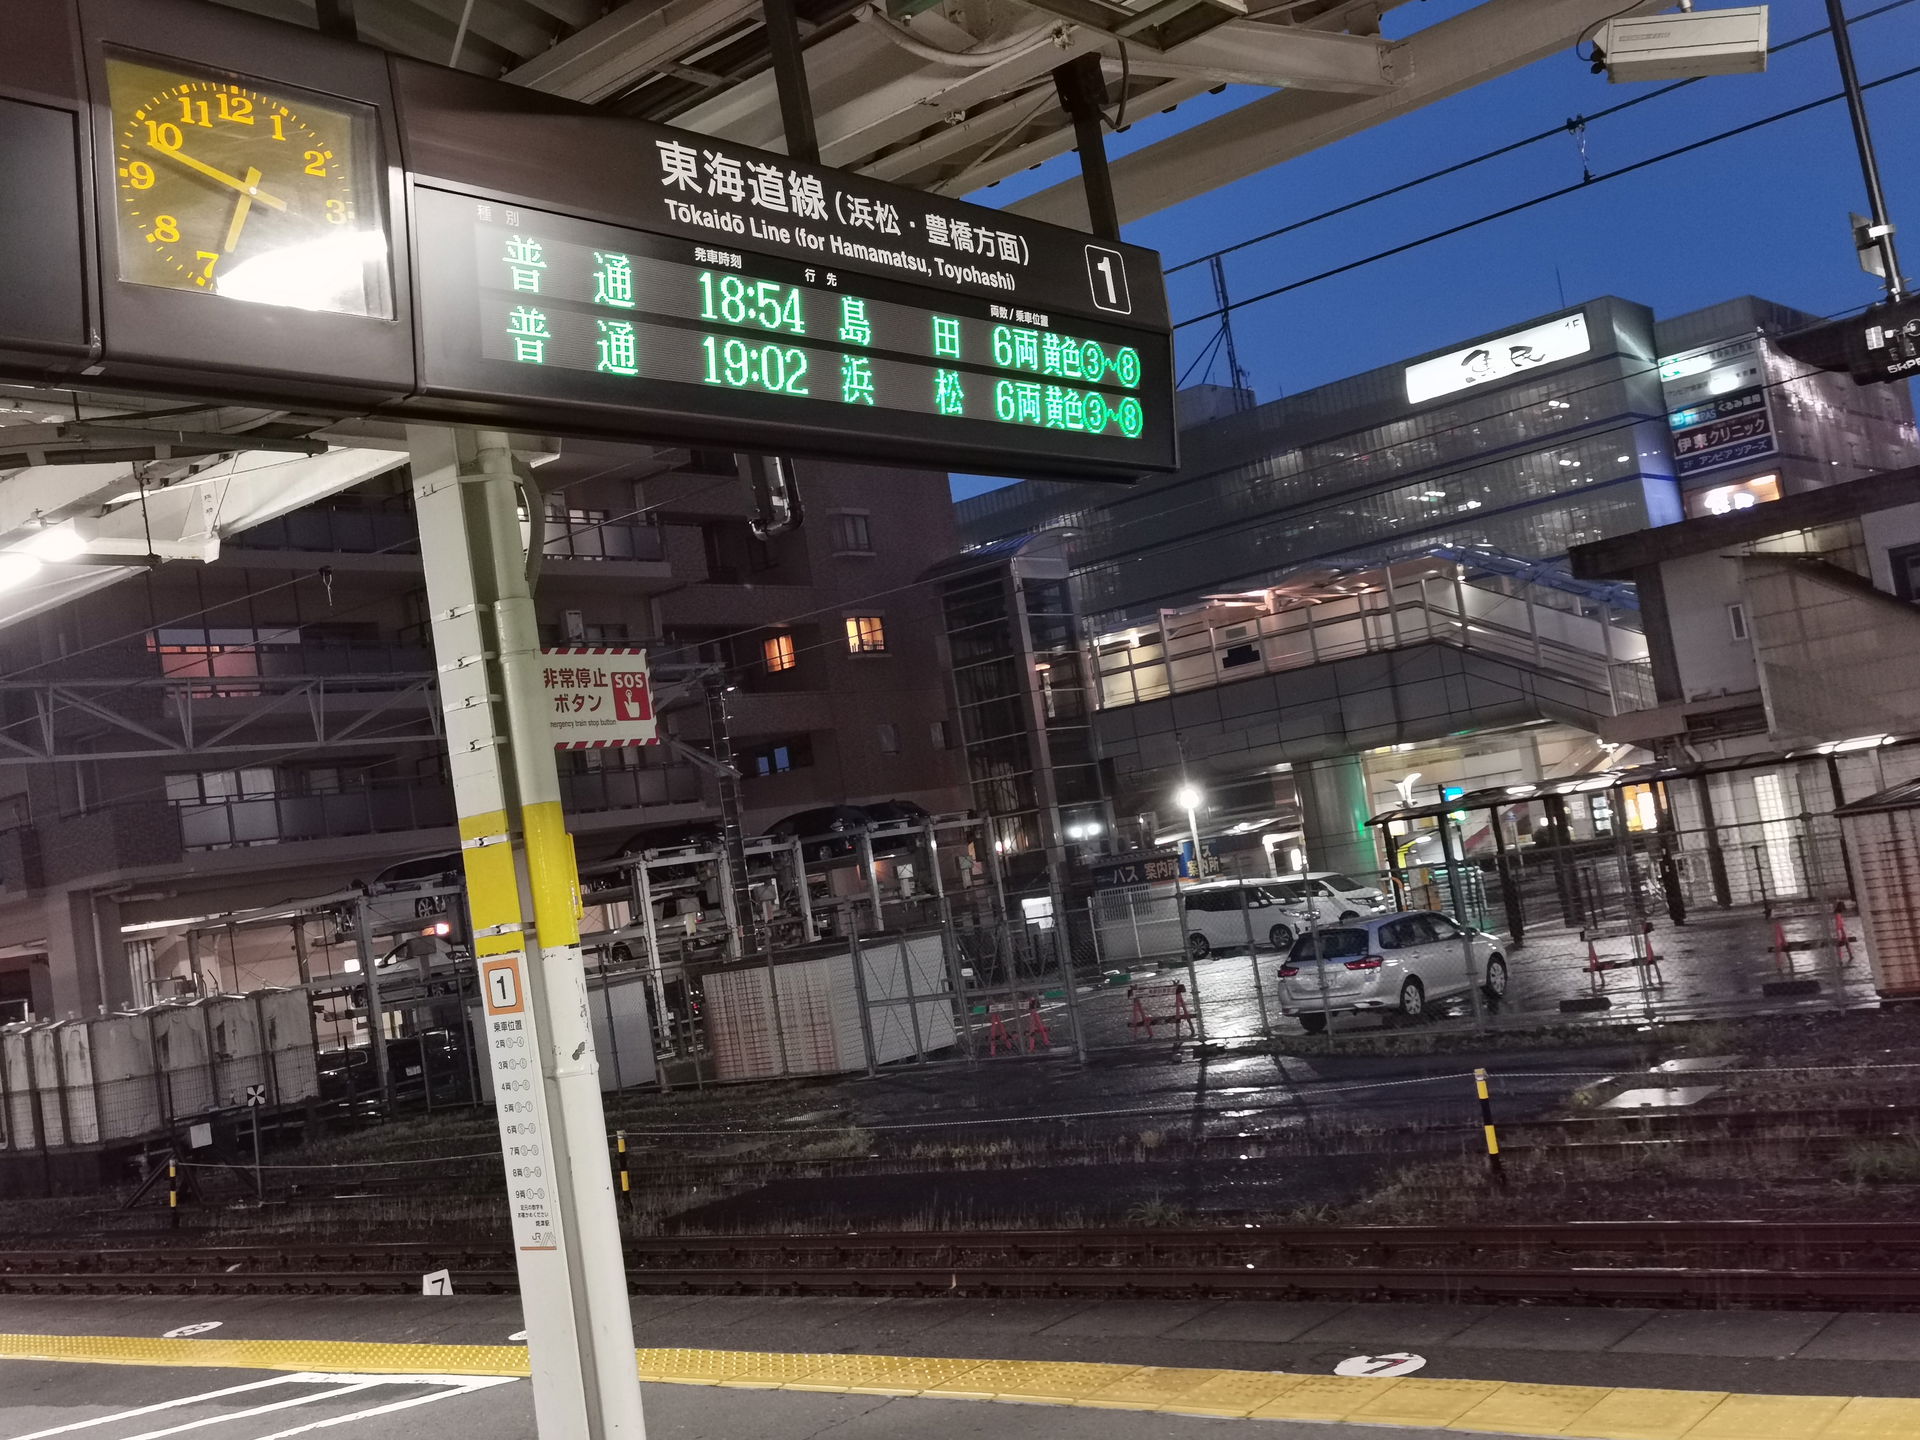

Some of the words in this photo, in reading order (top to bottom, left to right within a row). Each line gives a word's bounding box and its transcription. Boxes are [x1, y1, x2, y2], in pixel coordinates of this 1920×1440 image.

[178, 96, 213, 128] 11
[216, 93, 254, 125] 12
[145, 120, 183, 151] 10
[270, 115, 286, 141] 1
[128, 161, 155, 190] 9
[304, 150, 326, 177] 2
[656, 141, 829, 221] 東海道線
[326, 199, 347, 225] 3
[154, 215, 180, 243] 8
[196, 250, 219, 279] 7
[694, 247, 742, 269] 発車時刻
[750, 217, 791, 244] Line
[795, 227, 825, 252] (for
[830, 234, 932, 277] Hamamatsu,
[934, 257, 1016, 291] Toyohashi)
[1097, 256, 1117, 304] 1
[699, 271, 806, 334] 18:54
[703, 335, 809, 395] 19:02
[1677, 418, 1765, 453] 伊東クリニック
[543, 667, 609, 689] 非常停止
[614, 673, 644, 688] SOS
[554, 693, 602, 713] ボタン
[588, 719, 599, 728] stop
[1113, 865, 1140, 884] バス
[1143, 858, 1180, 880] 案内所
[496, 975, 507, 1000] 1
[532, 1232, 542, 1241] JR
[431, 1277, 445, 1296] 7
